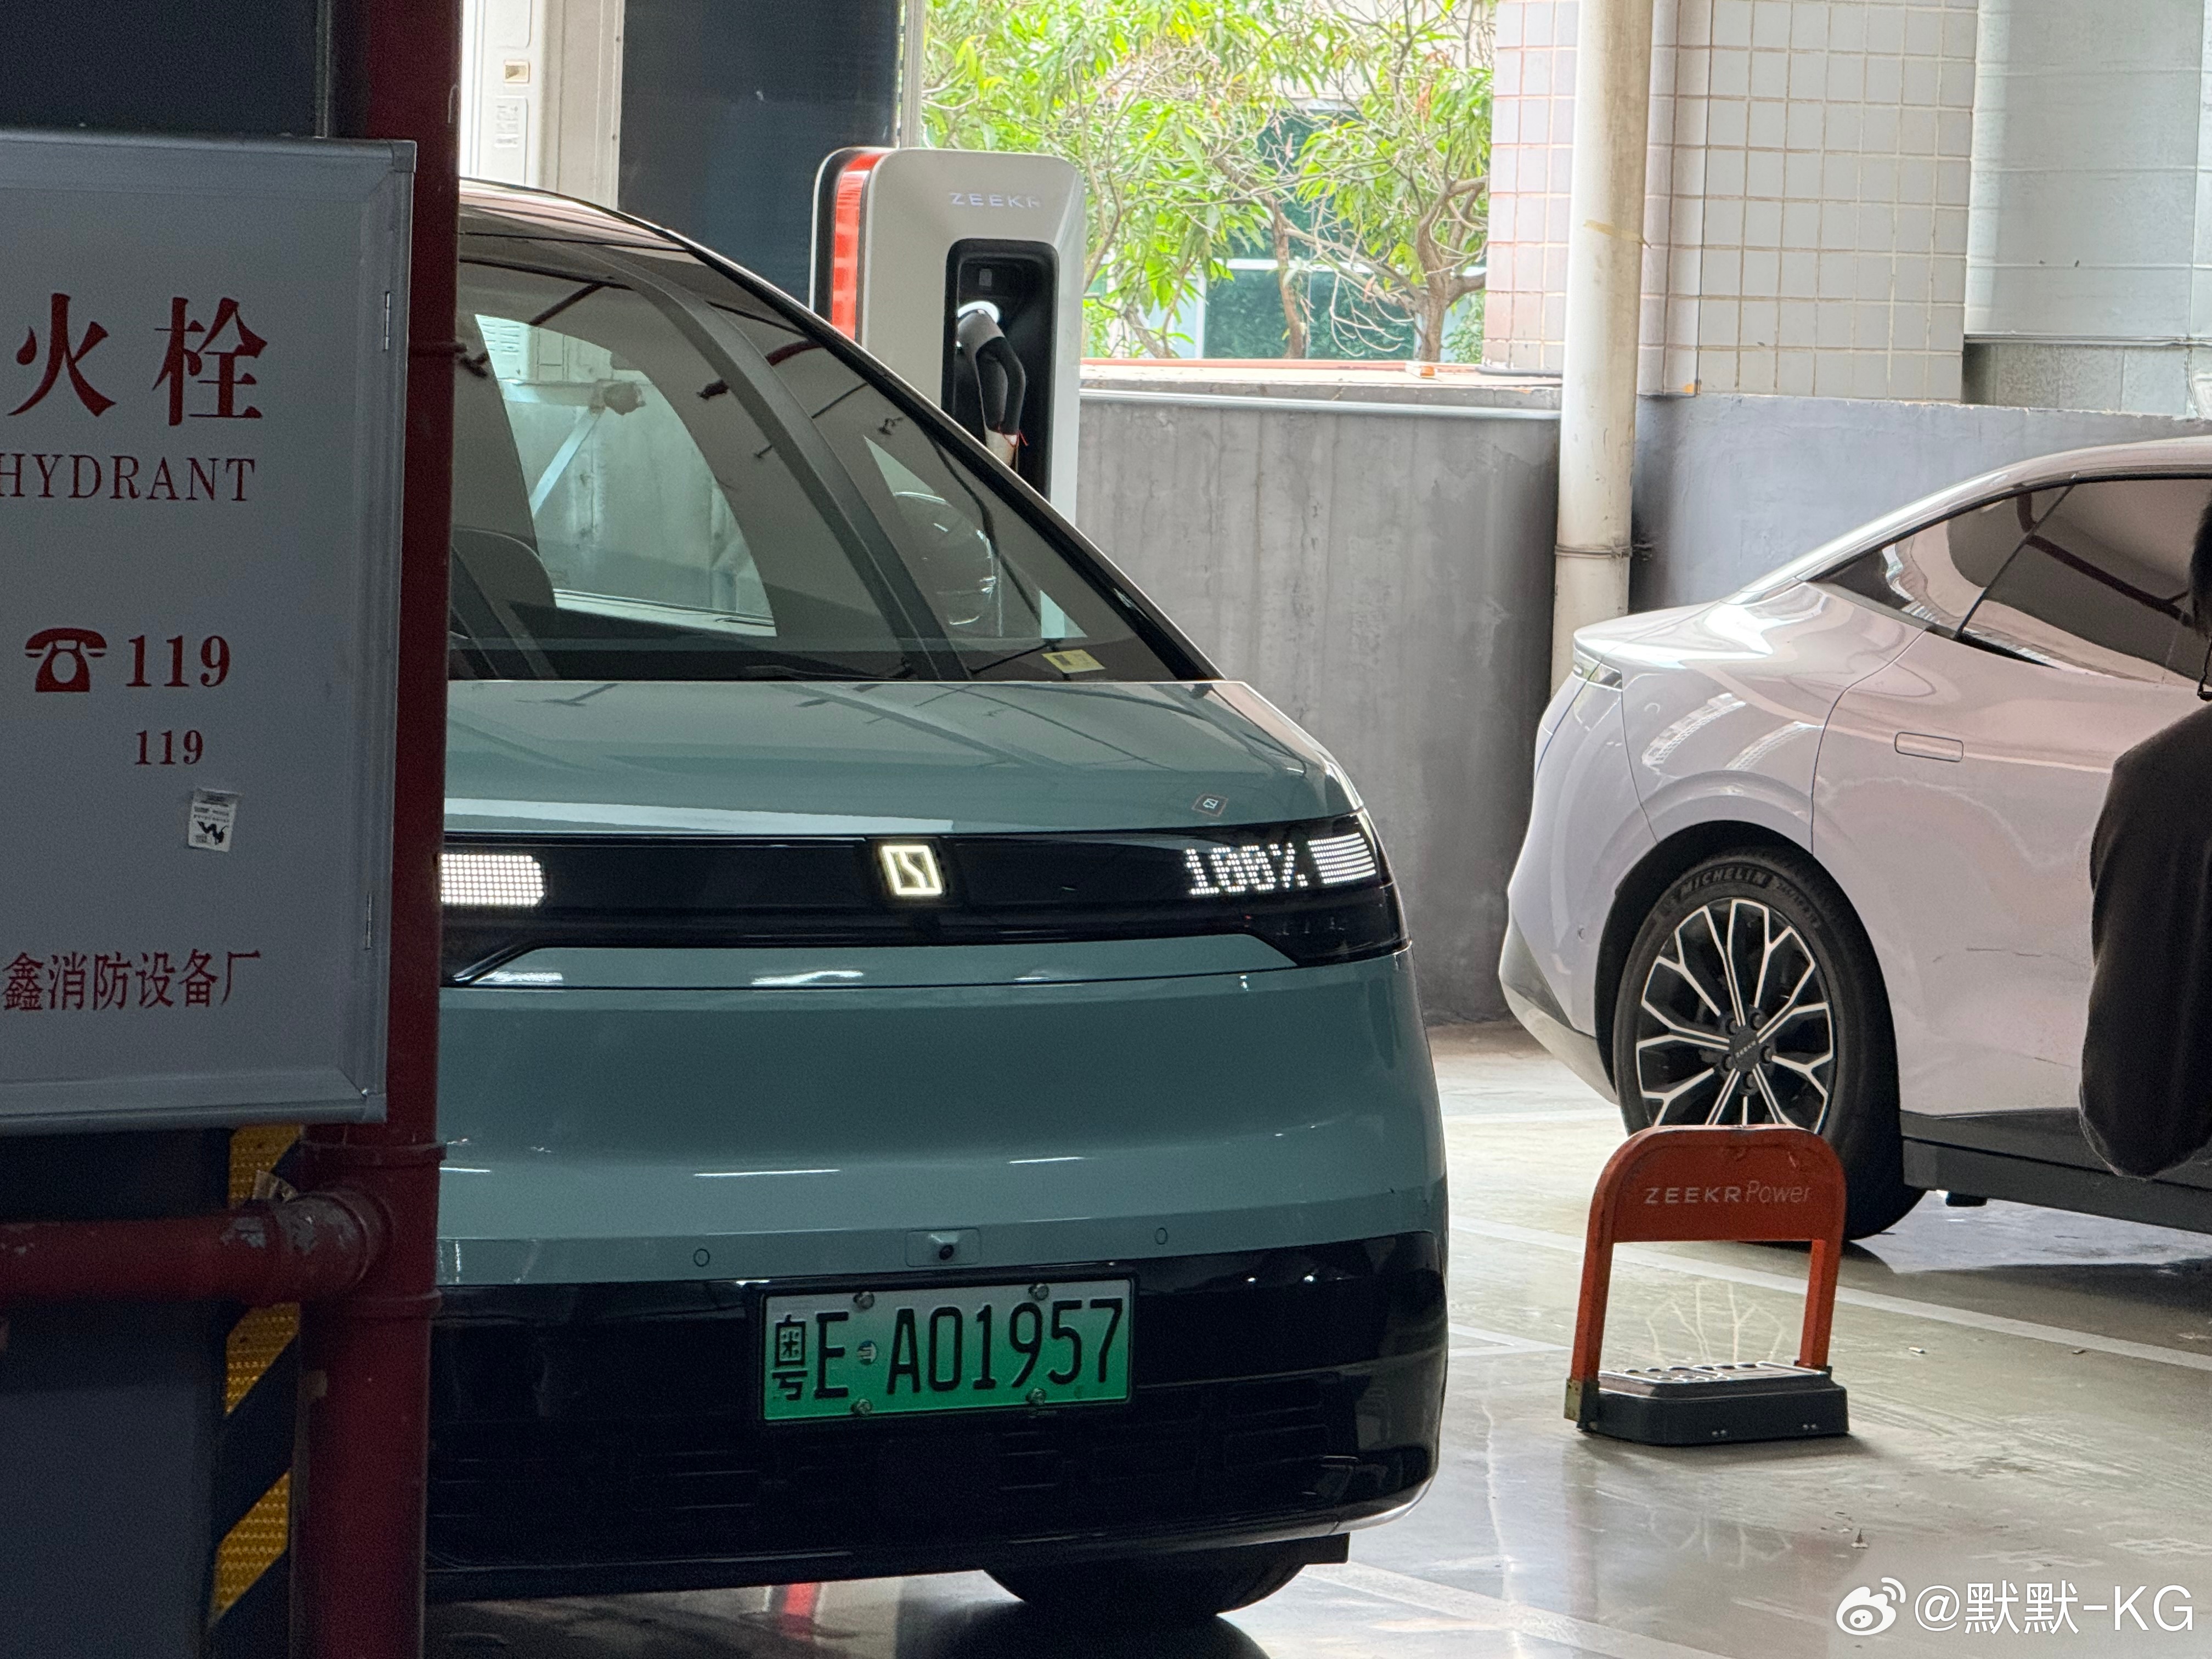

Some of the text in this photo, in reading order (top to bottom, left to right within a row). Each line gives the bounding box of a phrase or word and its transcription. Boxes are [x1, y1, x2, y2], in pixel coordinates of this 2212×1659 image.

[949, 192, 1041, 208] ZEEKR
[8, 293, 268, 426] 火栓
[0, 453, 256, 501] HYDRANT
[126, 634, 231, 687] 119
[134, 730, 204, 765] 119
[1186, 842, 1308, 895] 100%
[1681, 867, 1767, 893] MICHELIN
[2, 948, 261, 1011] 鑫消防设备厂
